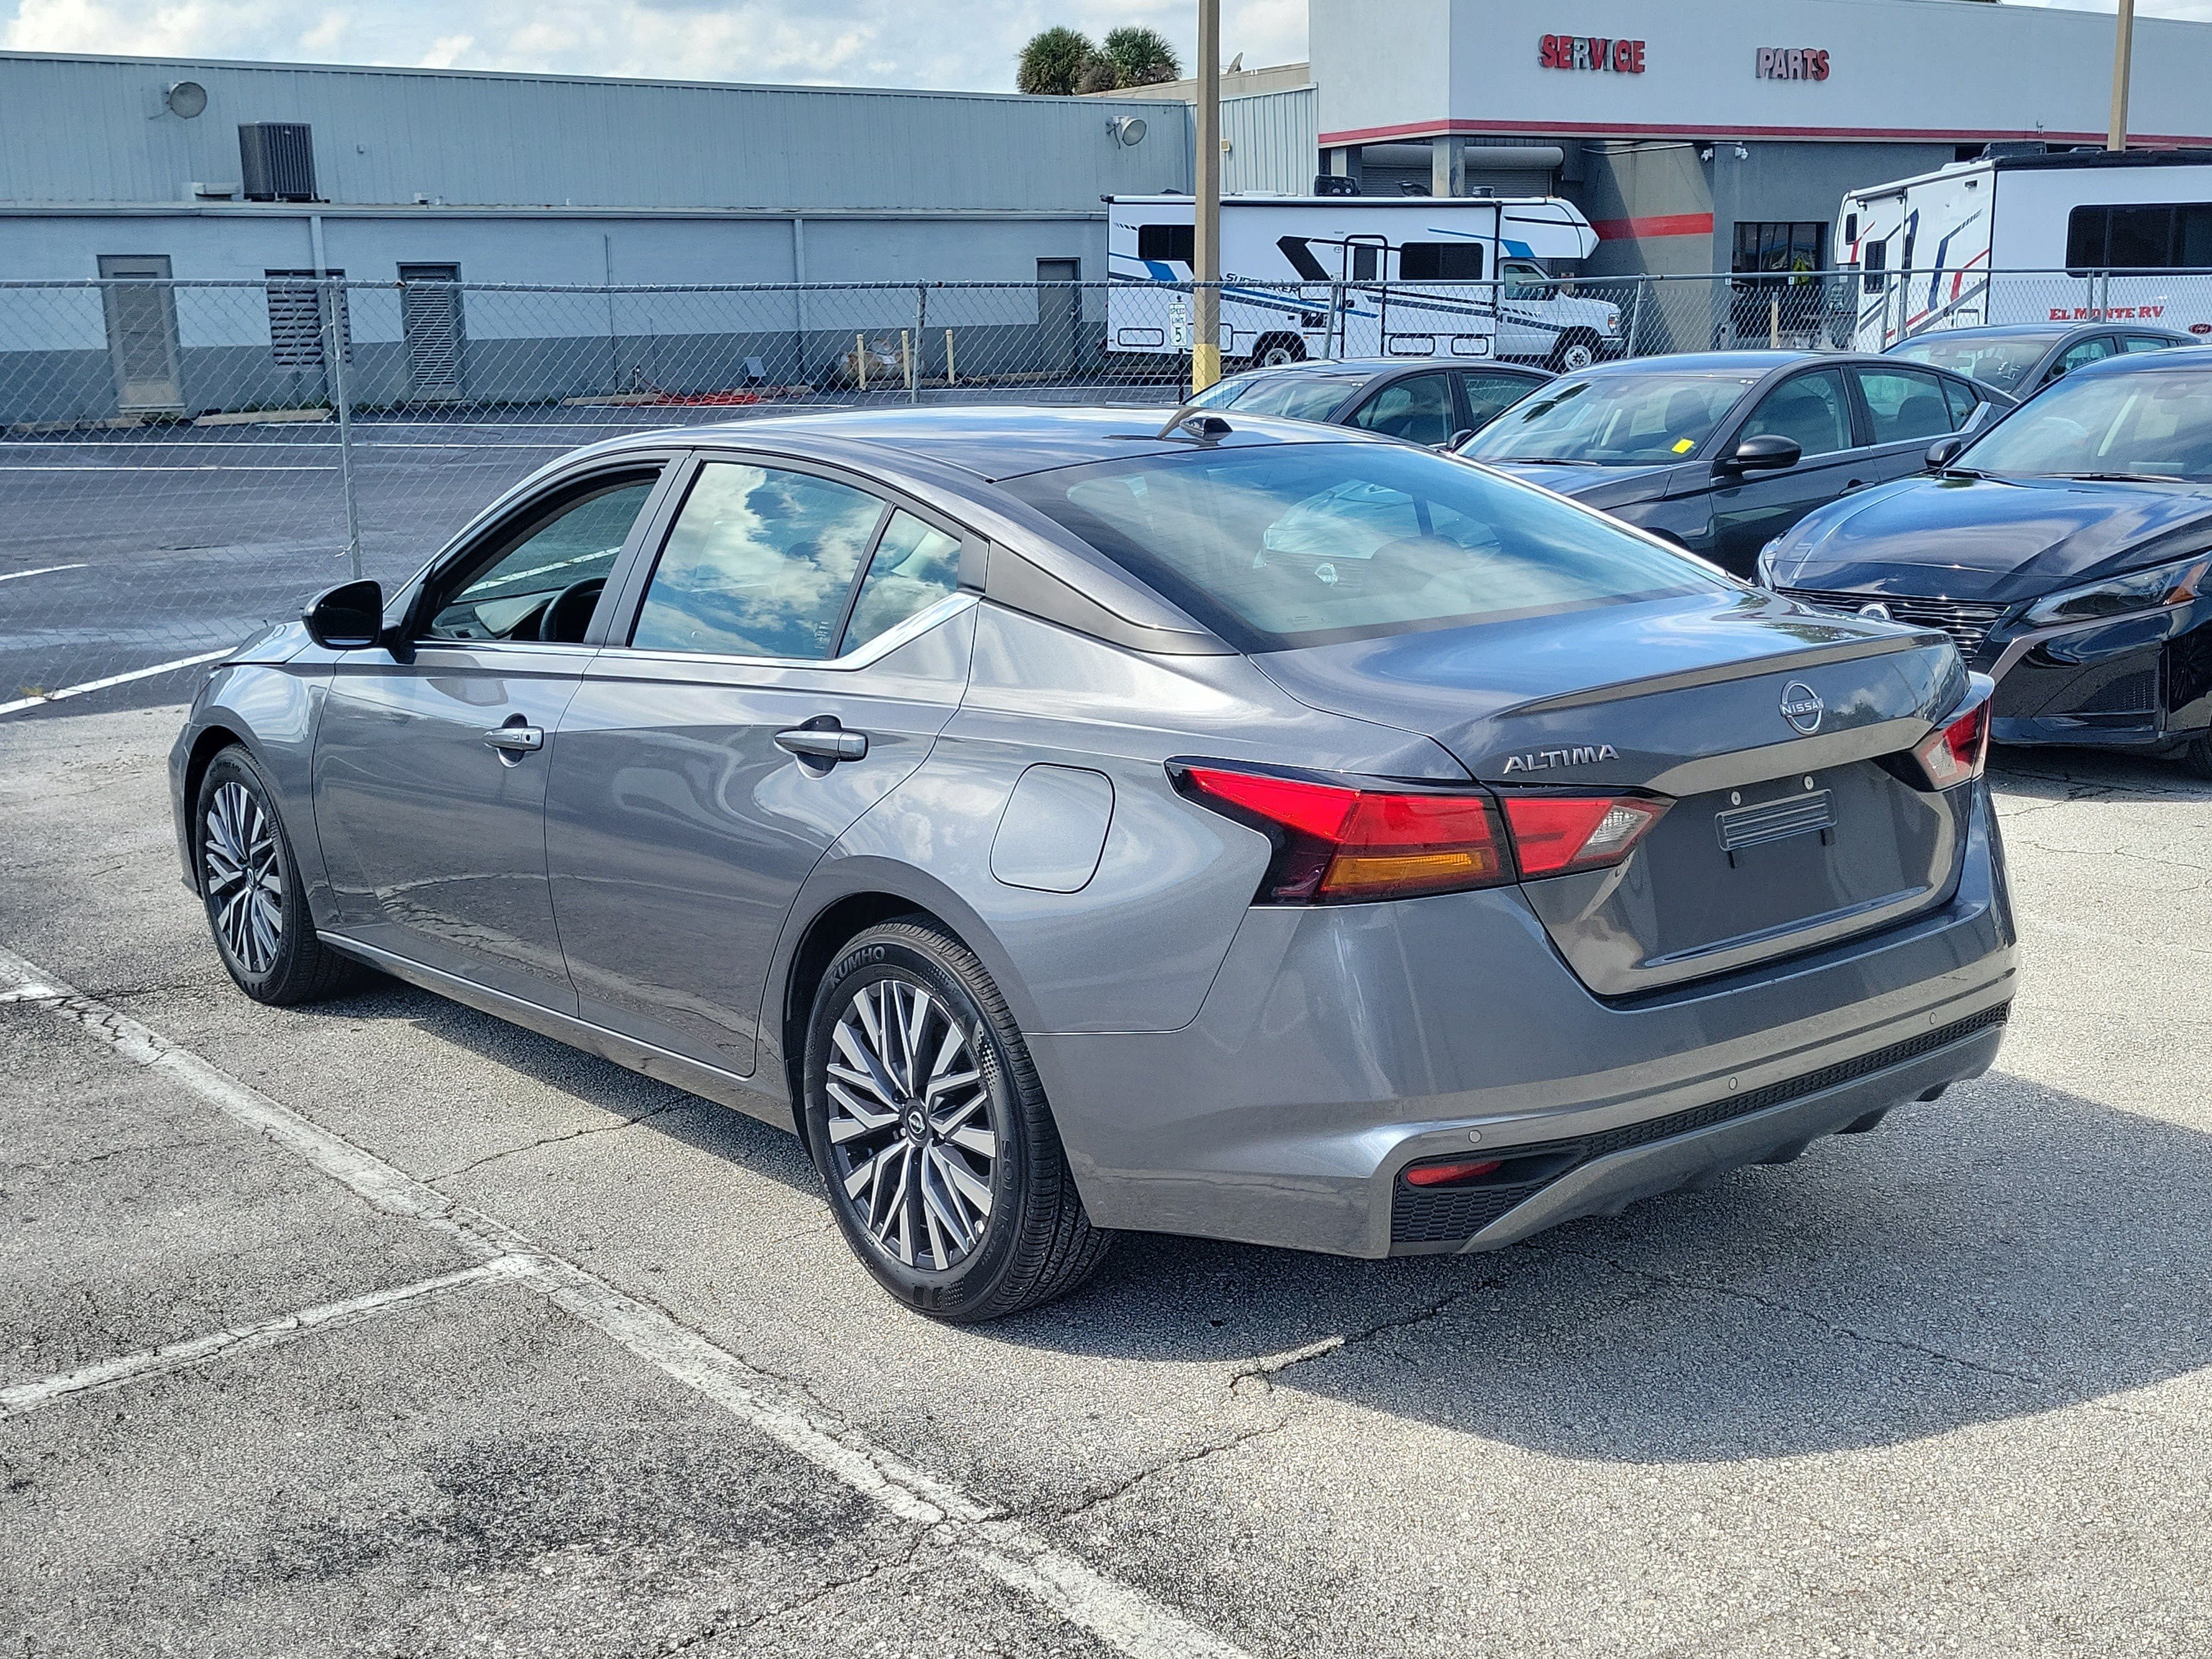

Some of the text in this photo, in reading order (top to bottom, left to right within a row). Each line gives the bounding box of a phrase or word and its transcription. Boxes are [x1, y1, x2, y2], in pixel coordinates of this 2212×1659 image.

[1538, 33, 1646, 73] SERVICE
[1756, 47, 1830, 81] PARTS
[2049, 308, 2070, 320] EL
[2138, 306, 2164, 318] RV
[1176, 328, 1182, 342] 5
[1781, 700, 1824, 714] NISSAN
[1503, 744, 1620, 775] ALTIMA
[828, 946, 885, 988] KUMHO
